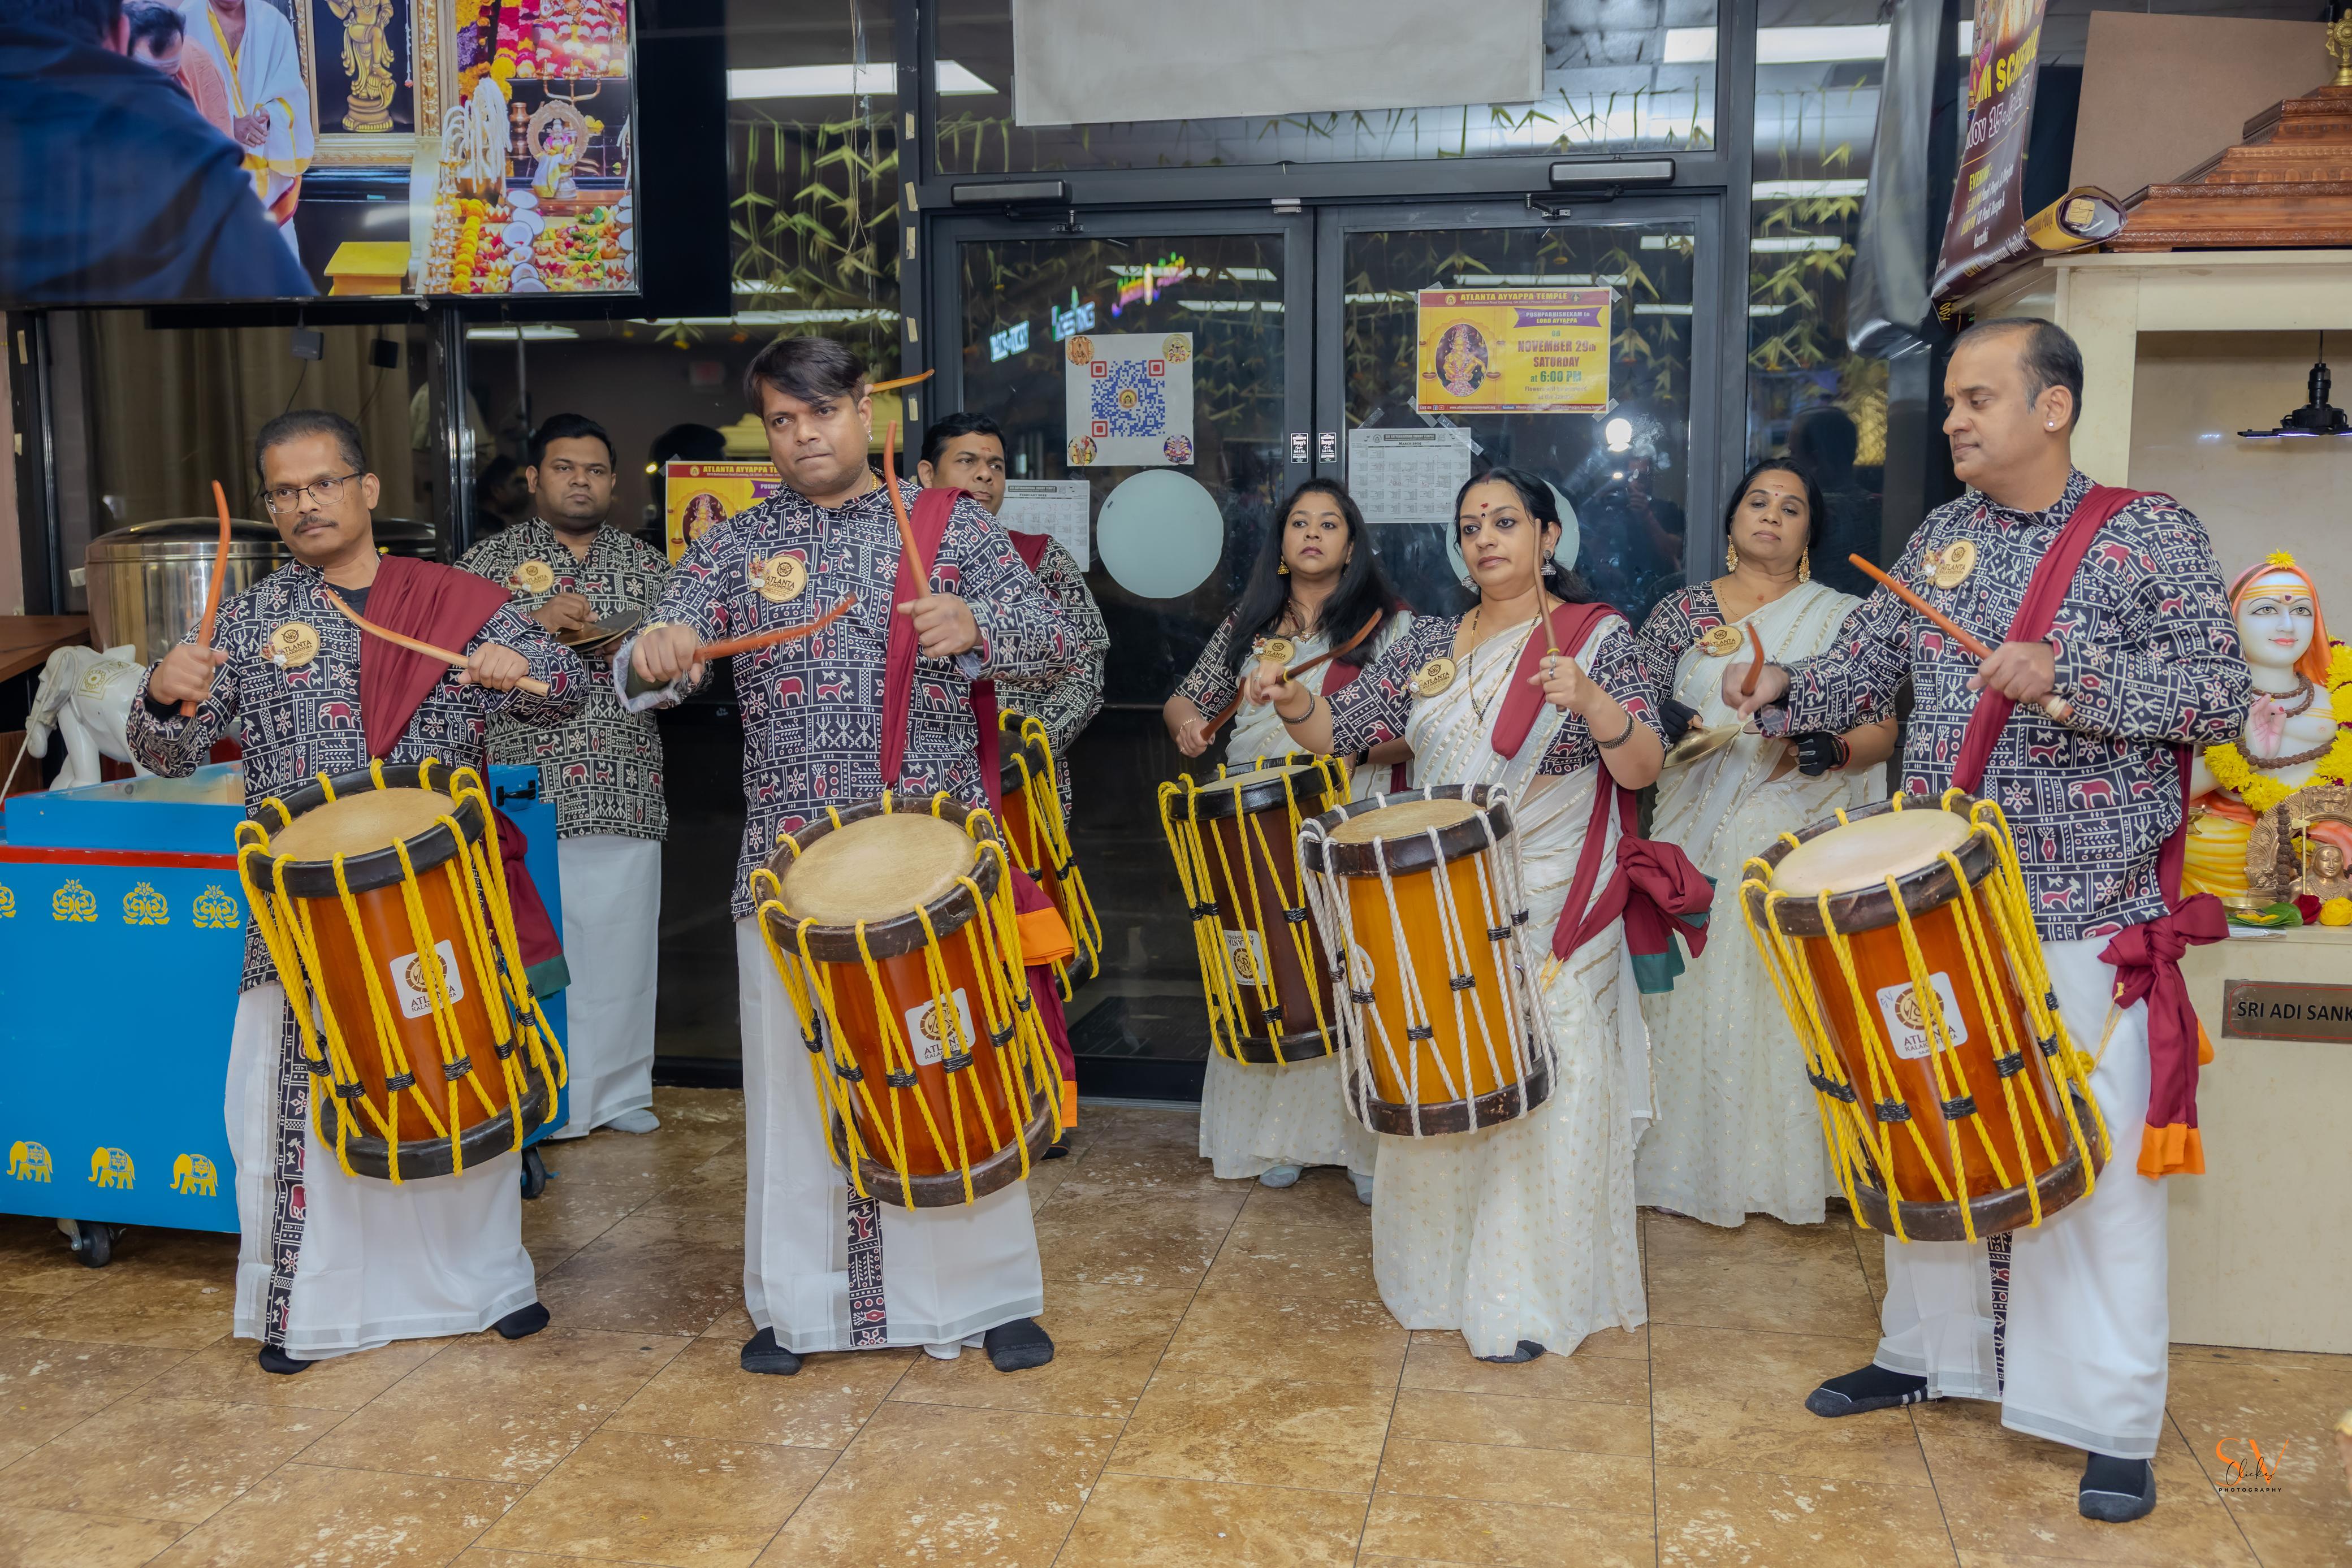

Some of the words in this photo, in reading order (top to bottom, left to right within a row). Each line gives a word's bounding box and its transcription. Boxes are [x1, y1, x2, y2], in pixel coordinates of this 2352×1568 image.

[1517, 340, 1572, 353] NOVEMBER
[1575, 340, 1596, 352] 29th
[1533, 357, 1580, 367] SATURDAY
[1540, 371, 1563, 382] 6:00
[1567, 371, 1581, 382] PM
[767, 575, 795, 588] ATLANTA
[284, 645, 313, 656] LAKSHETHRA
[1424, 672, 1450, 685] ATLANTA
[2237, 1001, 2264, 1017] SRI
[2269, 1003, 2301, 1020] ADI
[1904, 1025, 1955, 1046] ATLNA
